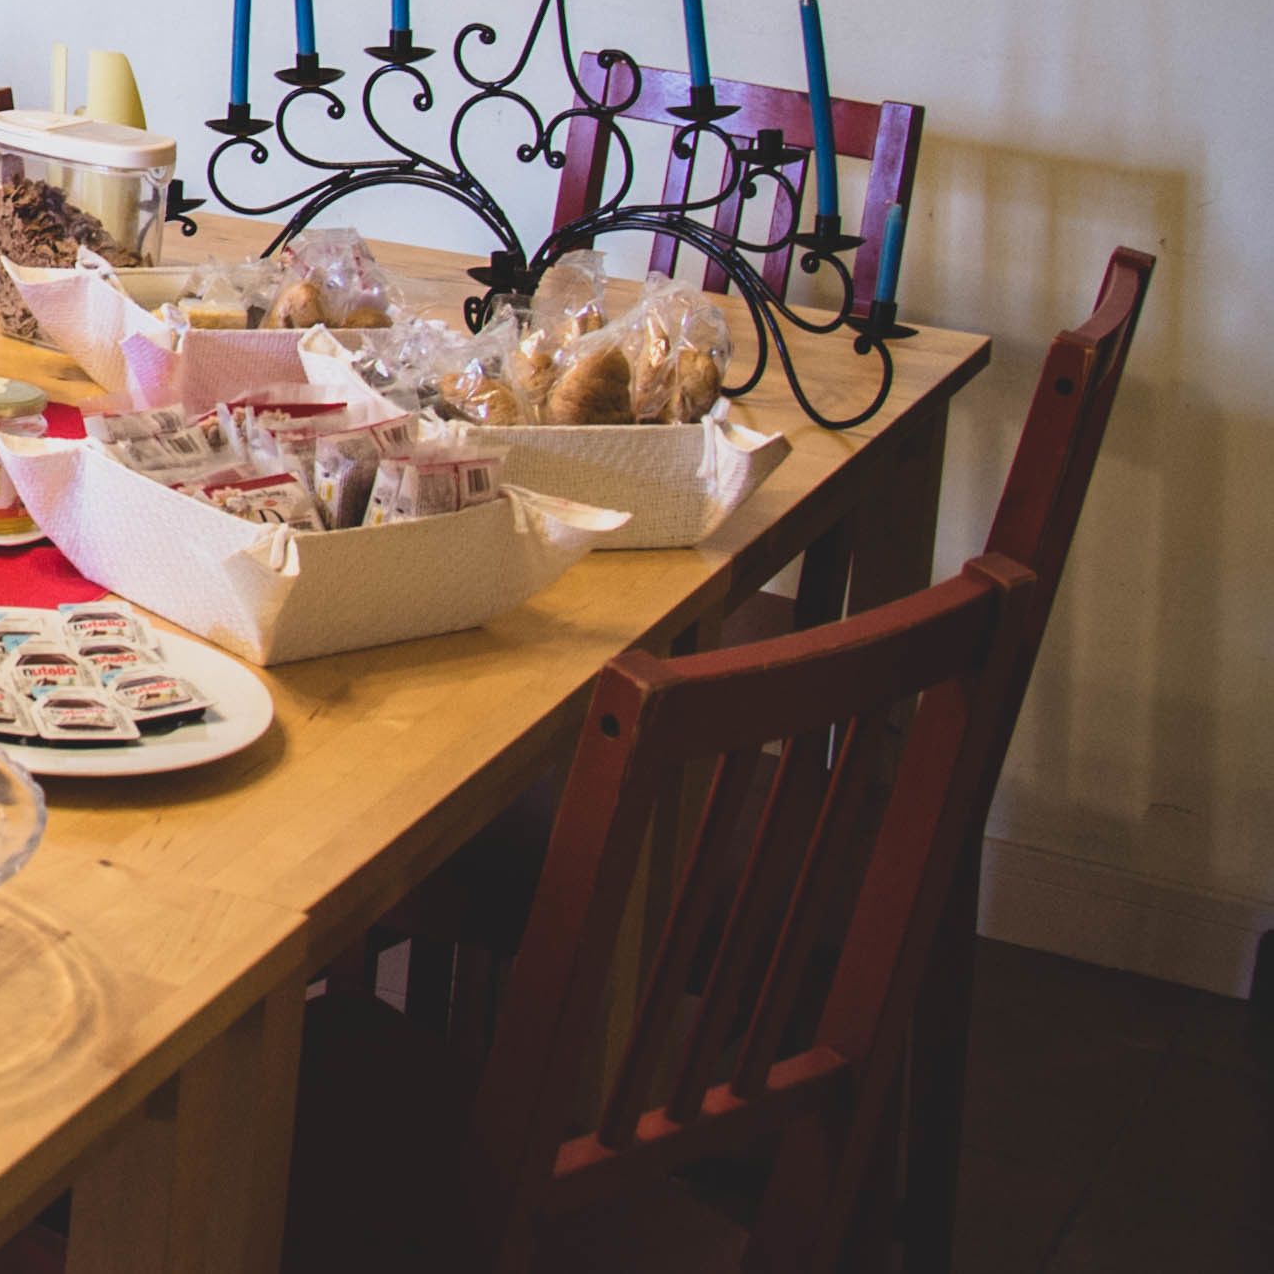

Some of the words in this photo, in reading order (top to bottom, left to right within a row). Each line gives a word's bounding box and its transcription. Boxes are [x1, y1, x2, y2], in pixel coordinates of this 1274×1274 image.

[74, 620, 127, 630] nutella
[23, 666, 76, 677] nutella
[124, 682, 177, 695] nutella
